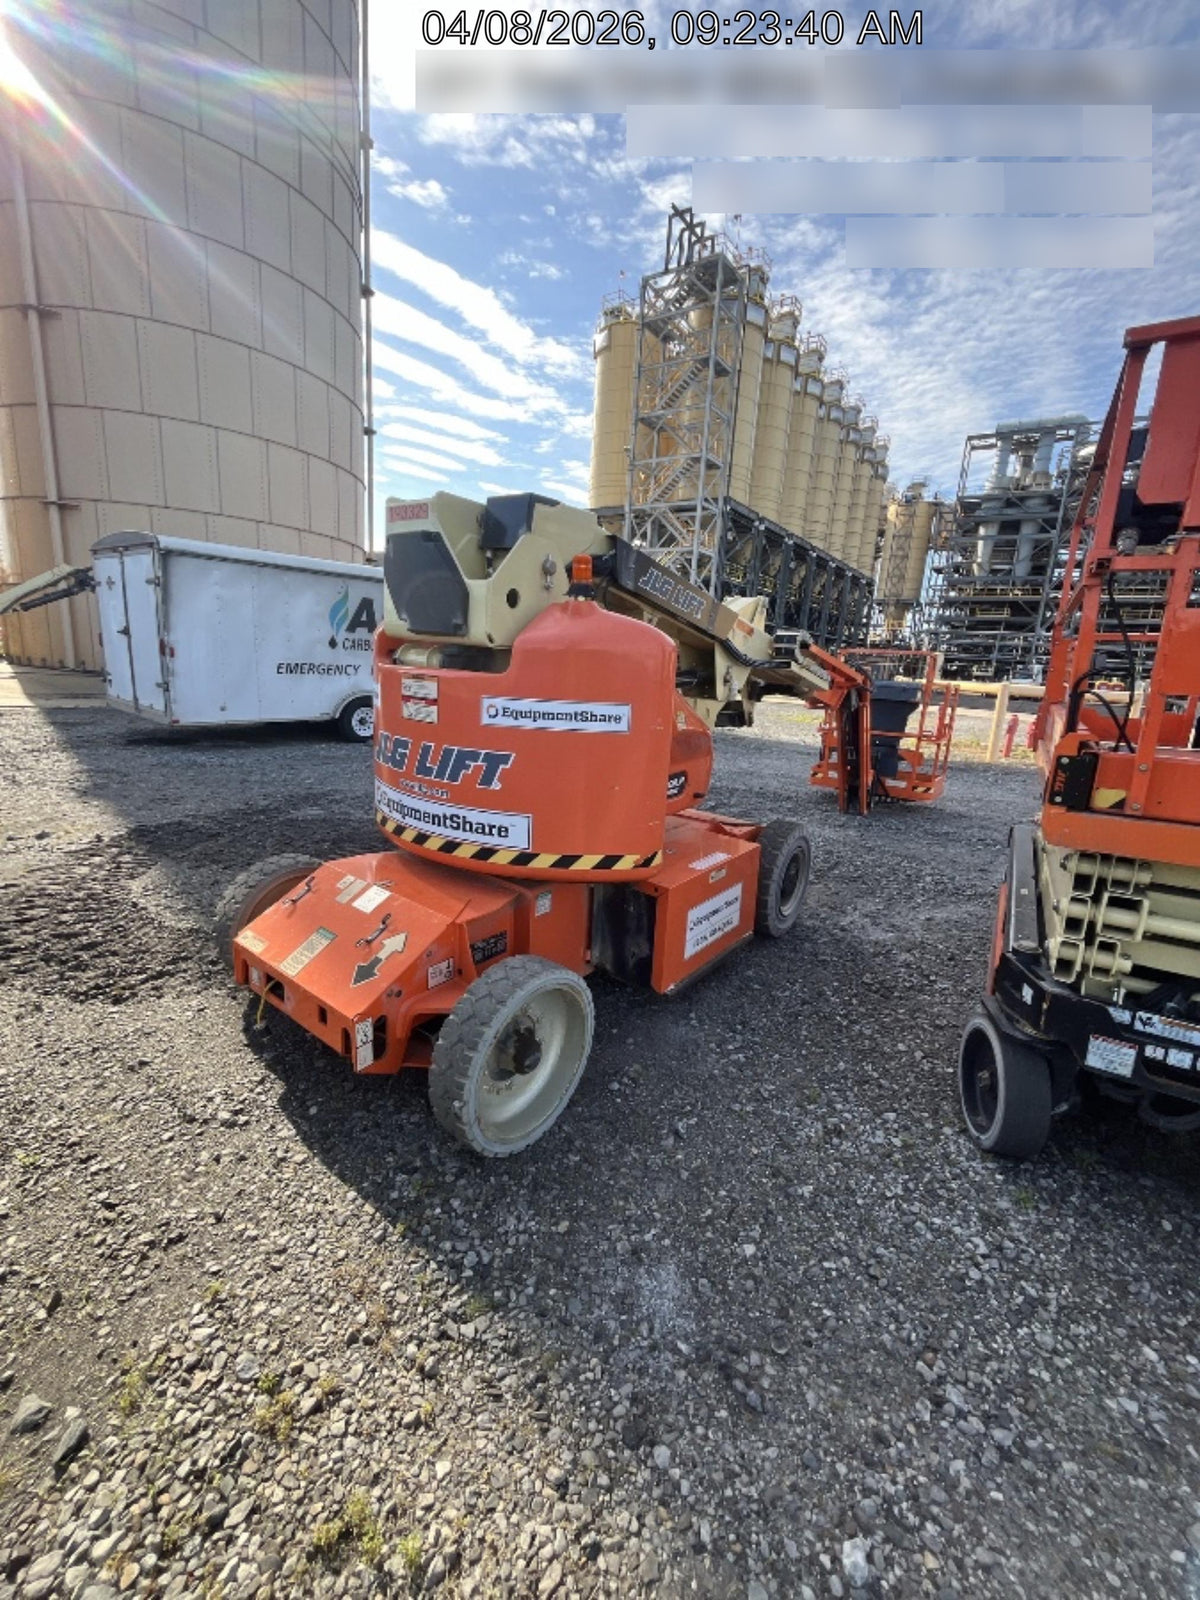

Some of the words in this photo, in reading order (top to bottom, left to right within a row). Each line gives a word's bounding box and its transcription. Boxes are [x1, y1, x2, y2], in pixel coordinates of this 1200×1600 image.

[638, 567, 674, 600] JLG
[671, 585, 706, 619] LIFT
[342, 638, 374, 652] CARB
[276, 662, 361, 676] EMERGENCY
[501, 706, 623, 724] EquipmentShare
[414, 741, 516, 789] LIFT
